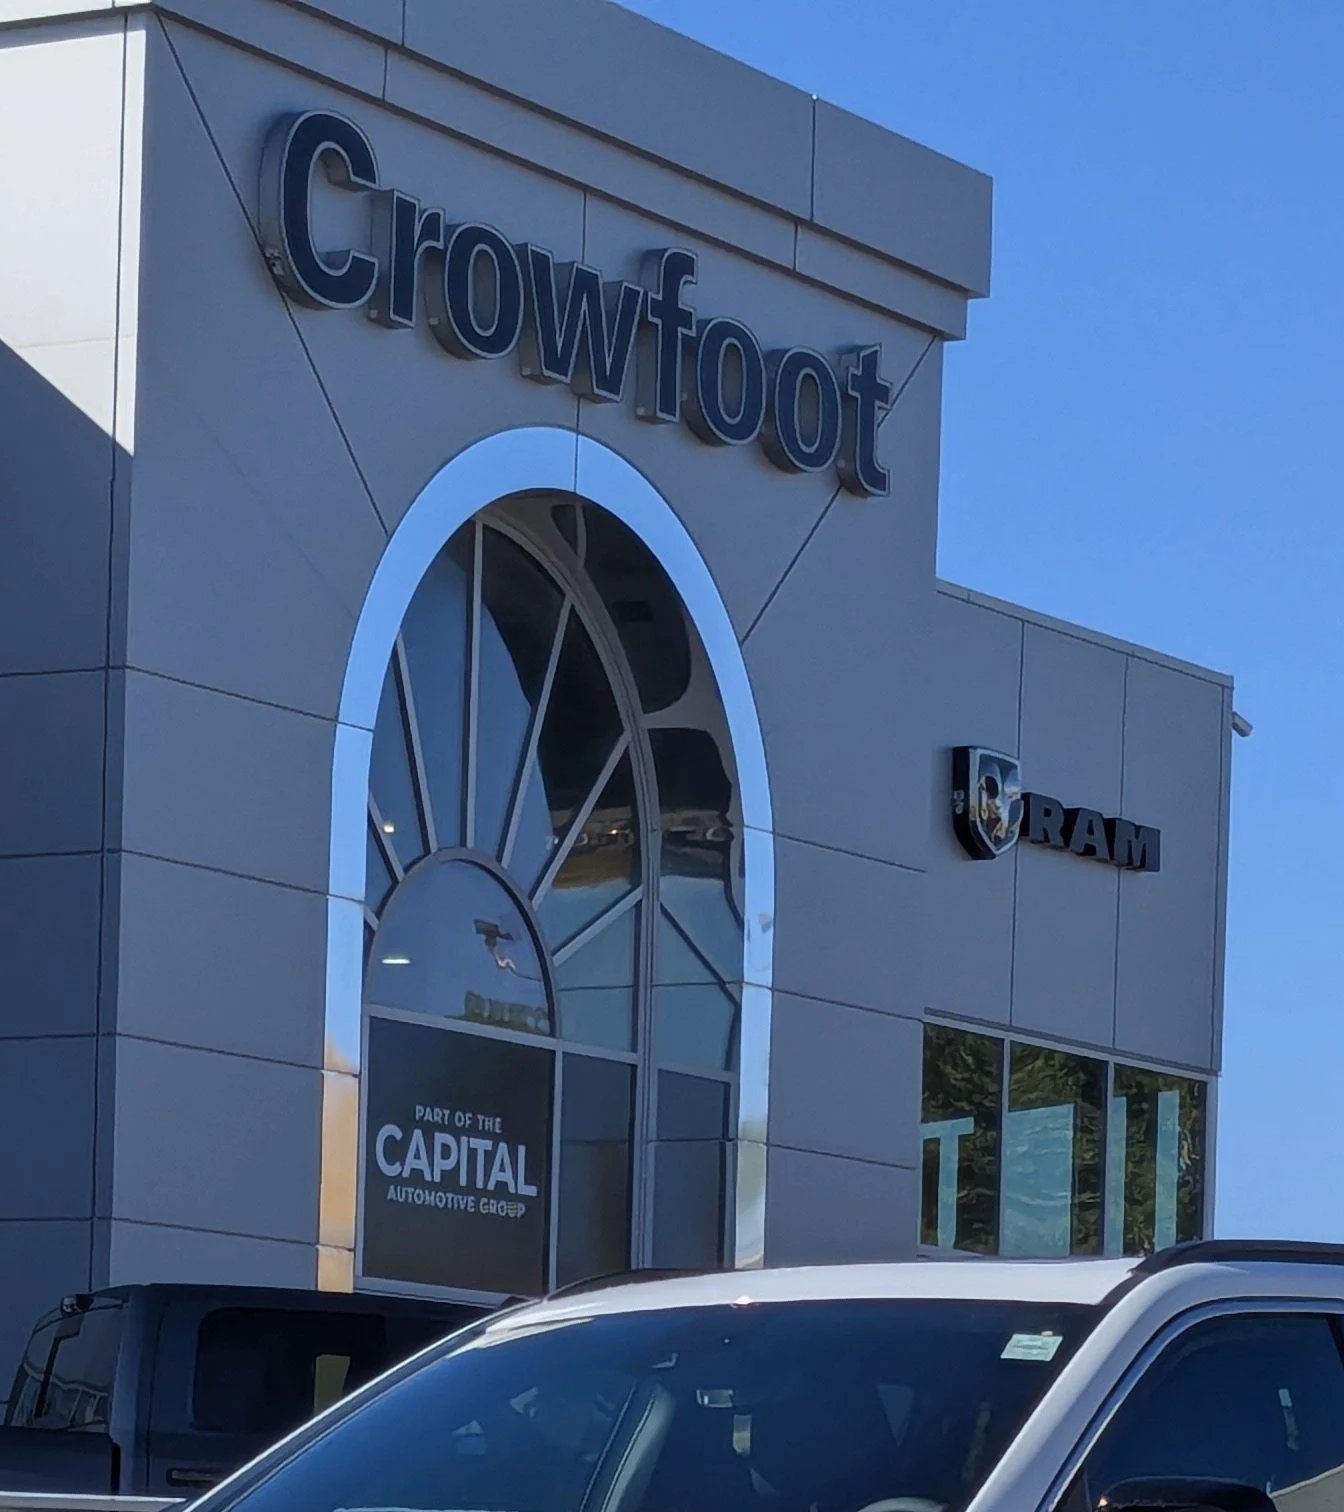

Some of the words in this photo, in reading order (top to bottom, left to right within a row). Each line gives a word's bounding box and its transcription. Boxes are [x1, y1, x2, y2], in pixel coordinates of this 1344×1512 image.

[264, 109, 891, 497] Crowfoot
[1024, 792, 1161, 872] RAM
[415, 1104, 450, 1126] PART
[454, 1111, 473, 1129] OF
[477, 1114, 503, 1134] THE
[375, 1123, 538, 1198] CAPITAL
[387, 1184, 476, 1213] AUTOMOTIVE
[479, 1197, 526, 1219] GROUP
